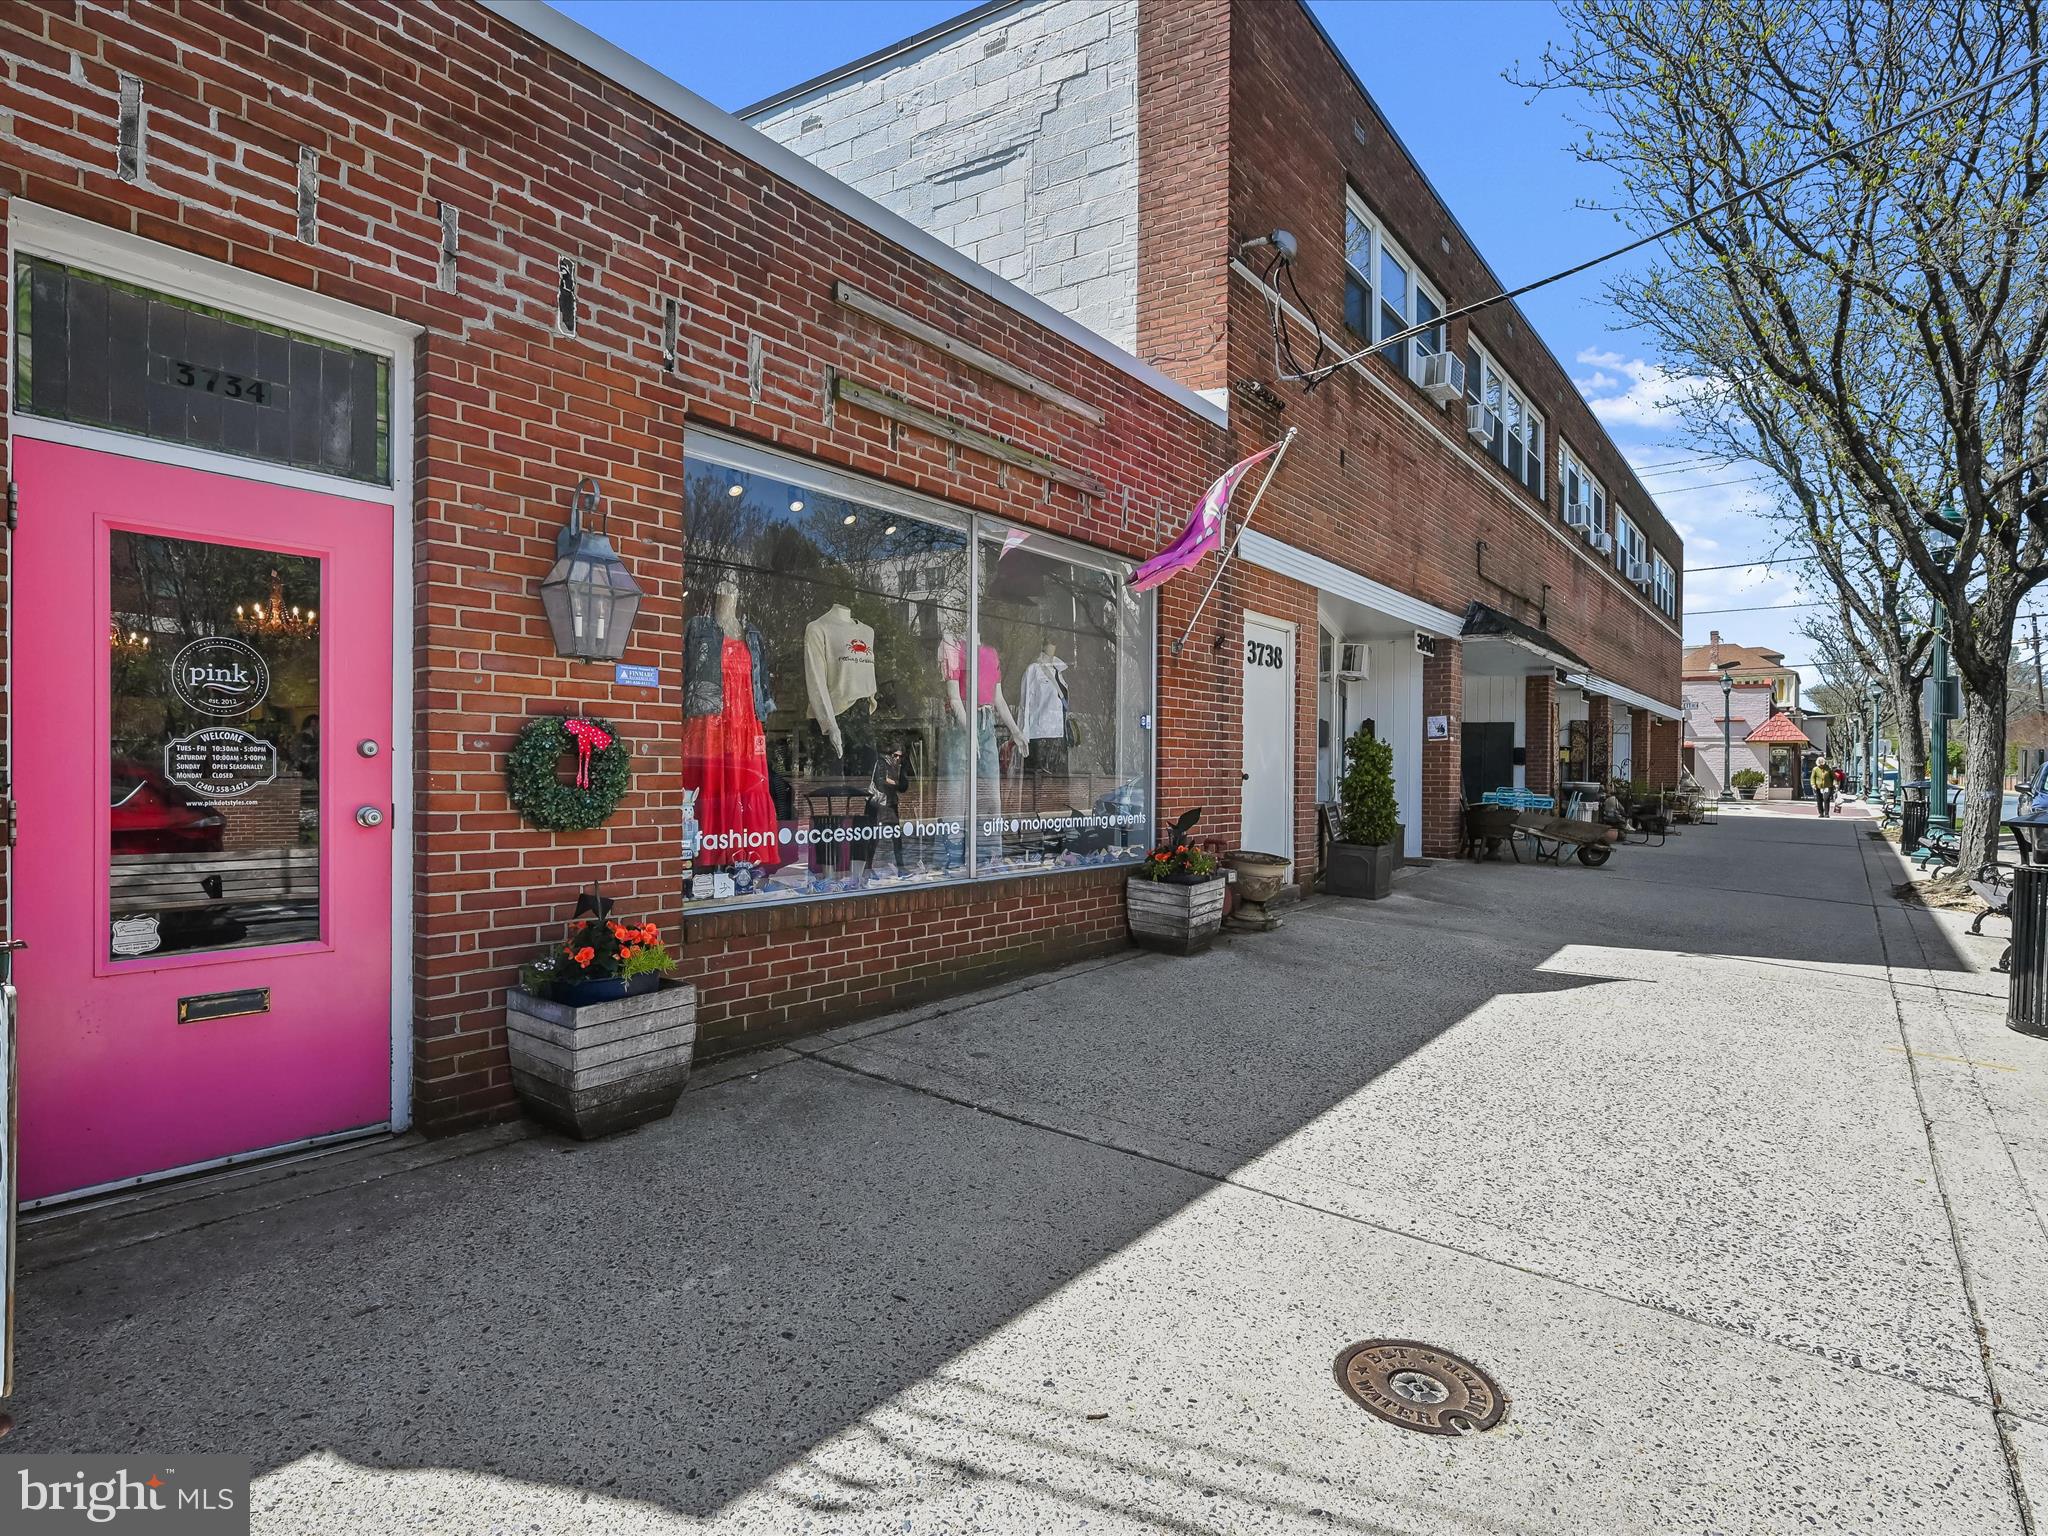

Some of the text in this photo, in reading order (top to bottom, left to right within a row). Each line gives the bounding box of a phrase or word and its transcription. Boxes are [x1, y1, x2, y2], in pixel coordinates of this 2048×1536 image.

[176, 362, 265, 404] 3734
[1247, 639, 1283, 669] 3738
[189, 662, 249, 686] pink
[200, 731, 244, 743] WELCOME
[195, 781, 215, 793] (240)
[186, 799, 258, 808] www.pinkdotstyles.com
[695, 820, 960, 851] fashion accessories home
[983, 811, 1147, 837] gifts monogramming events
[1355, 1379, 1434, 1425] WATER
